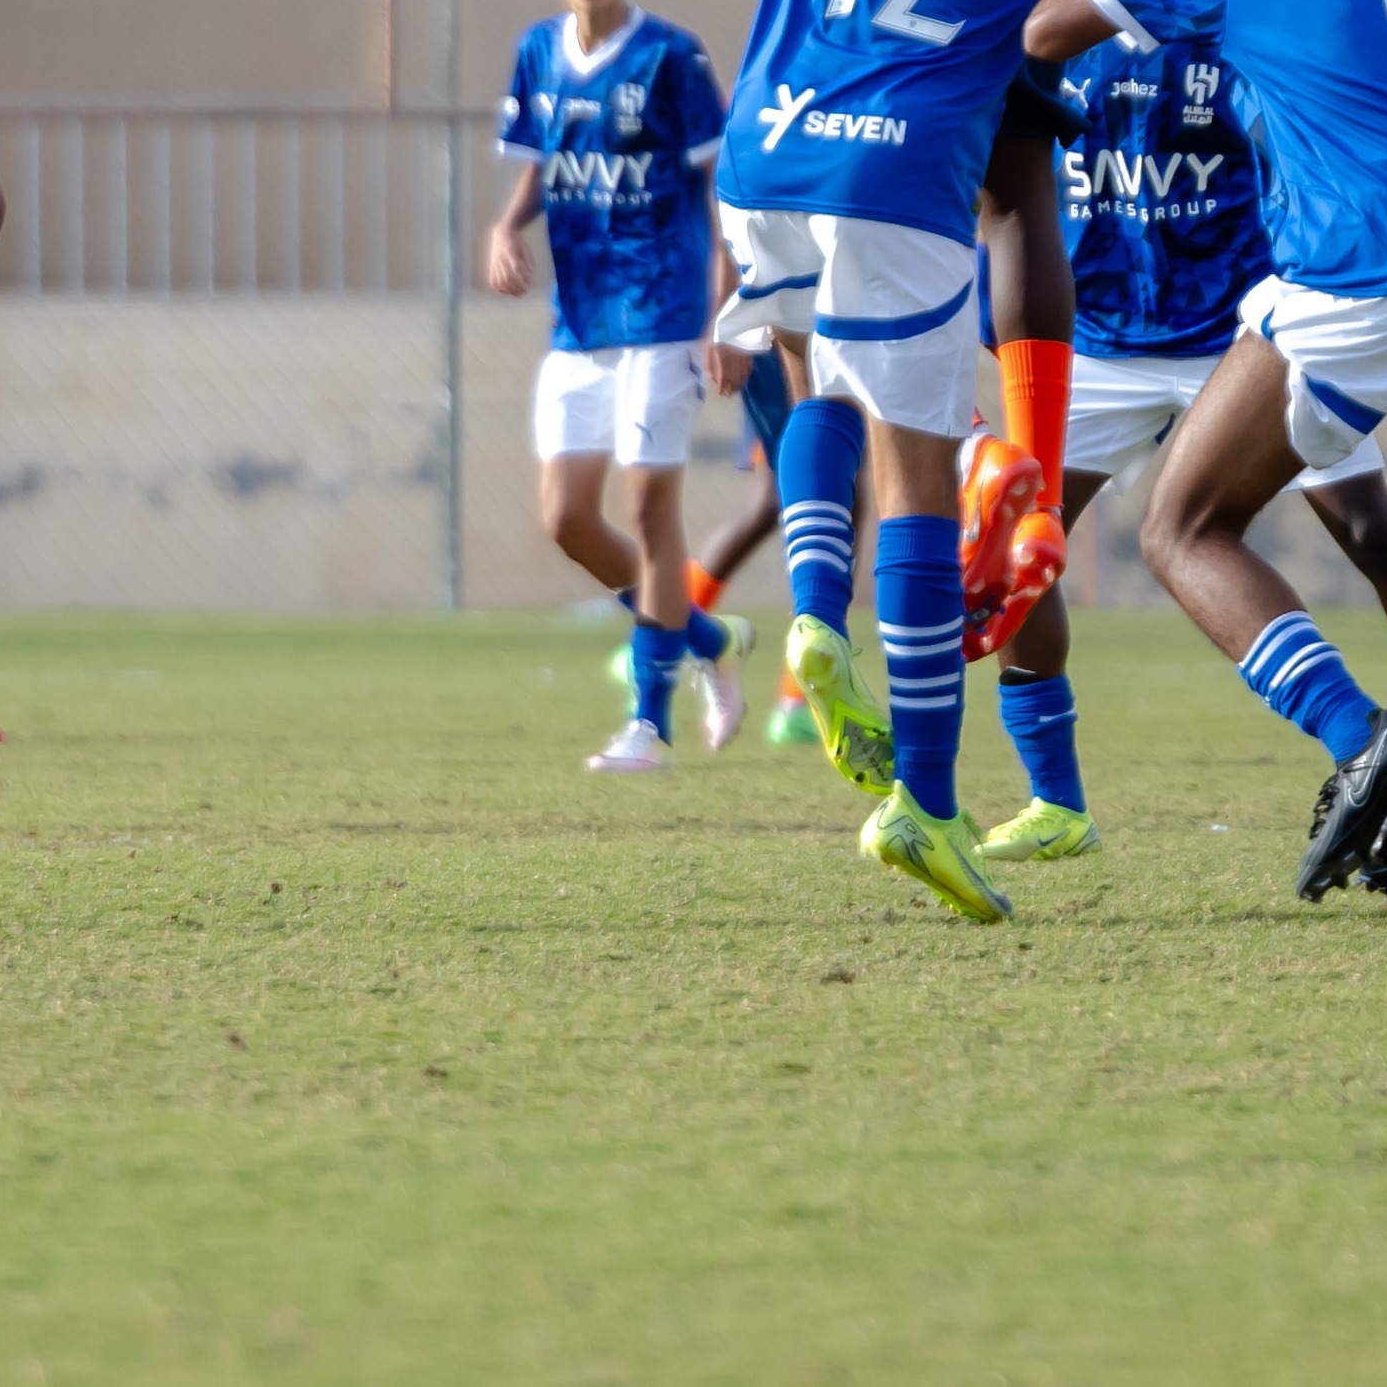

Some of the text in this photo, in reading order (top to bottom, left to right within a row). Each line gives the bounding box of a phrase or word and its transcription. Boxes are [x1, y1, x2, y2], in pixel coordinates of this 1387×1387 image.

[803, 111, 907, 145] SEVEN
[1070, 199, 1218, 222] GAMES GROUP
